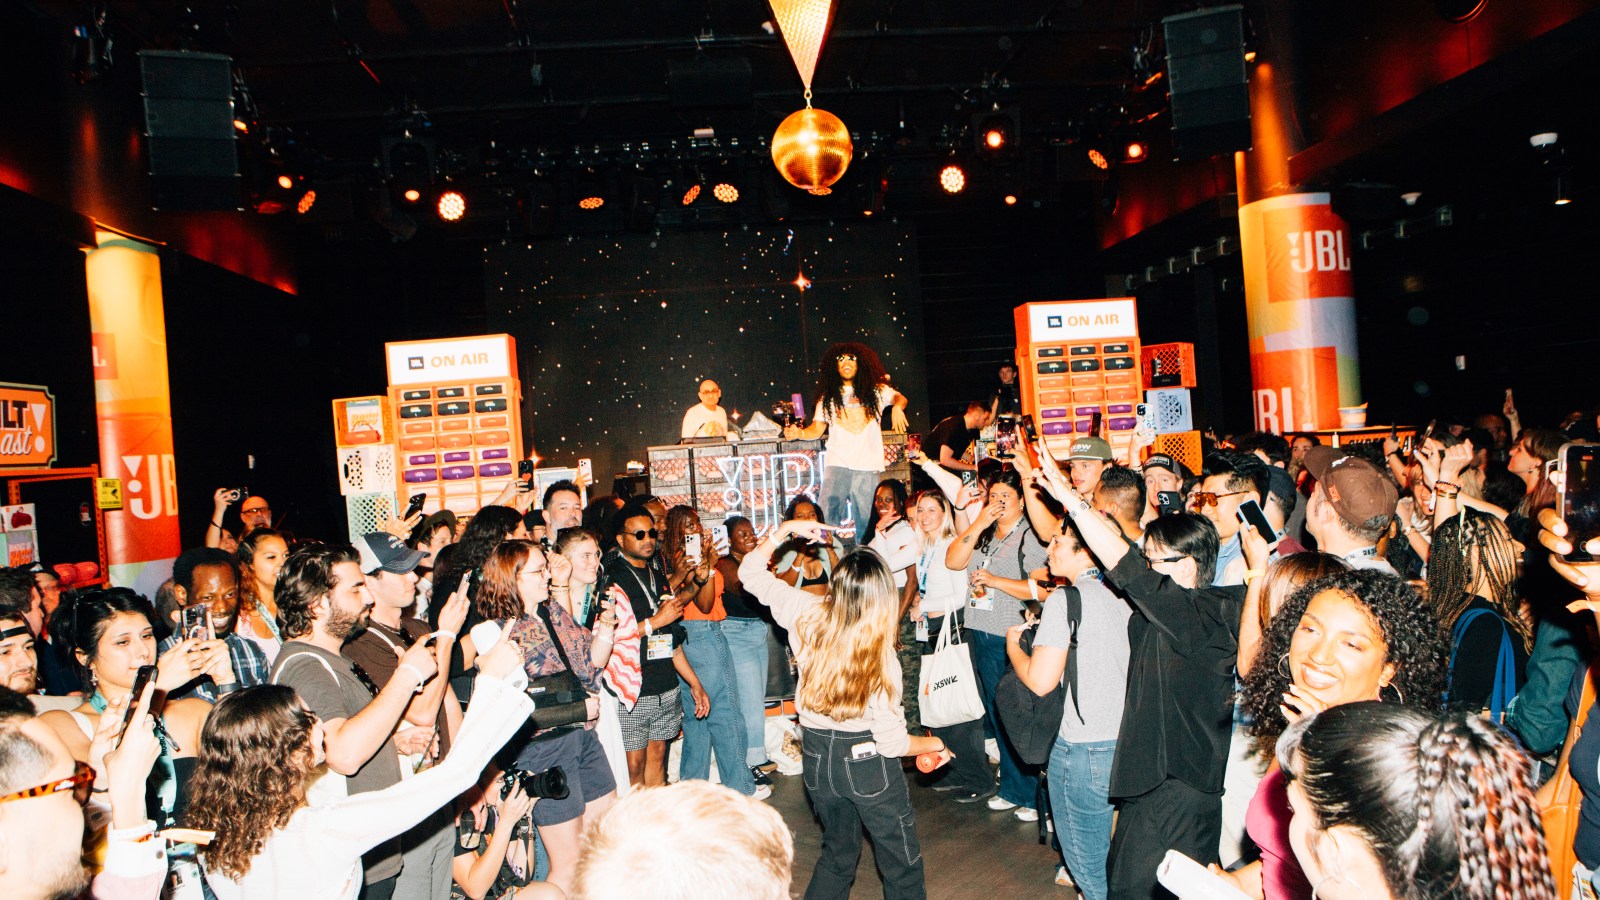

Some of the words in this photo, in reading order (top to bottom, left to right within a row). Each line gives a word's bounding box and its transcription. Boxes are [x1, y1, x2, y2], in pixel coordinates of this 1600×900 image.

[1287, 229, 1350, 273] JBL
[1067, 315, 1090, 327] ON
[1094, 313, 1119, 325] AIR
[430, 355, 456, 368] ON
[460, 352, 489, 366] AIR
